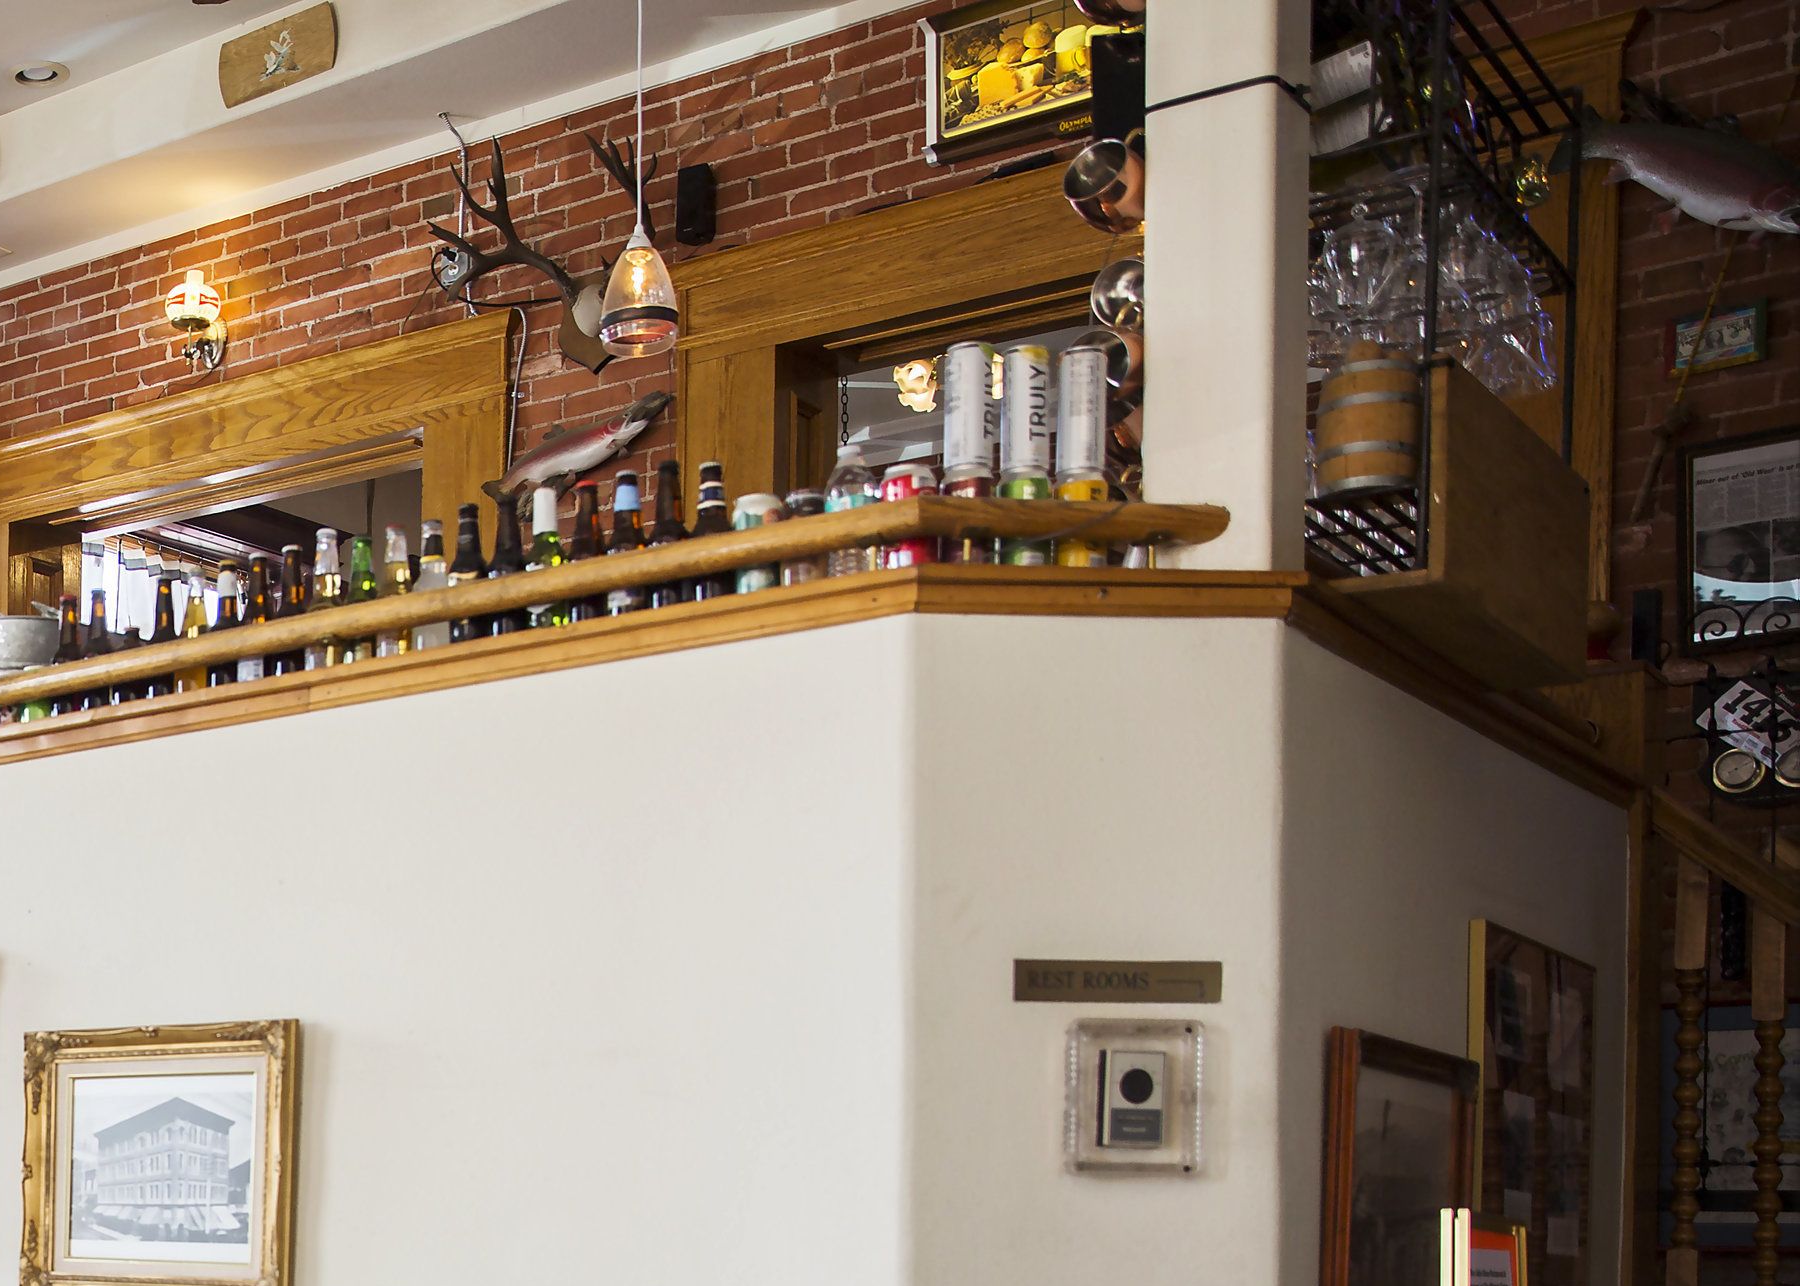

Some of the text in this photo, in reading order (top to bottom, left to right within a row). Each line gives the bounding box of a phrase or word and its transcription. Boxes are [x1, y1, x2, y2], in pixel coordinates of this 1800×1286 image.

[1029, 364, 1046, 442] TRULY
[1027, 971, 1150, 990] REST ROOMS
